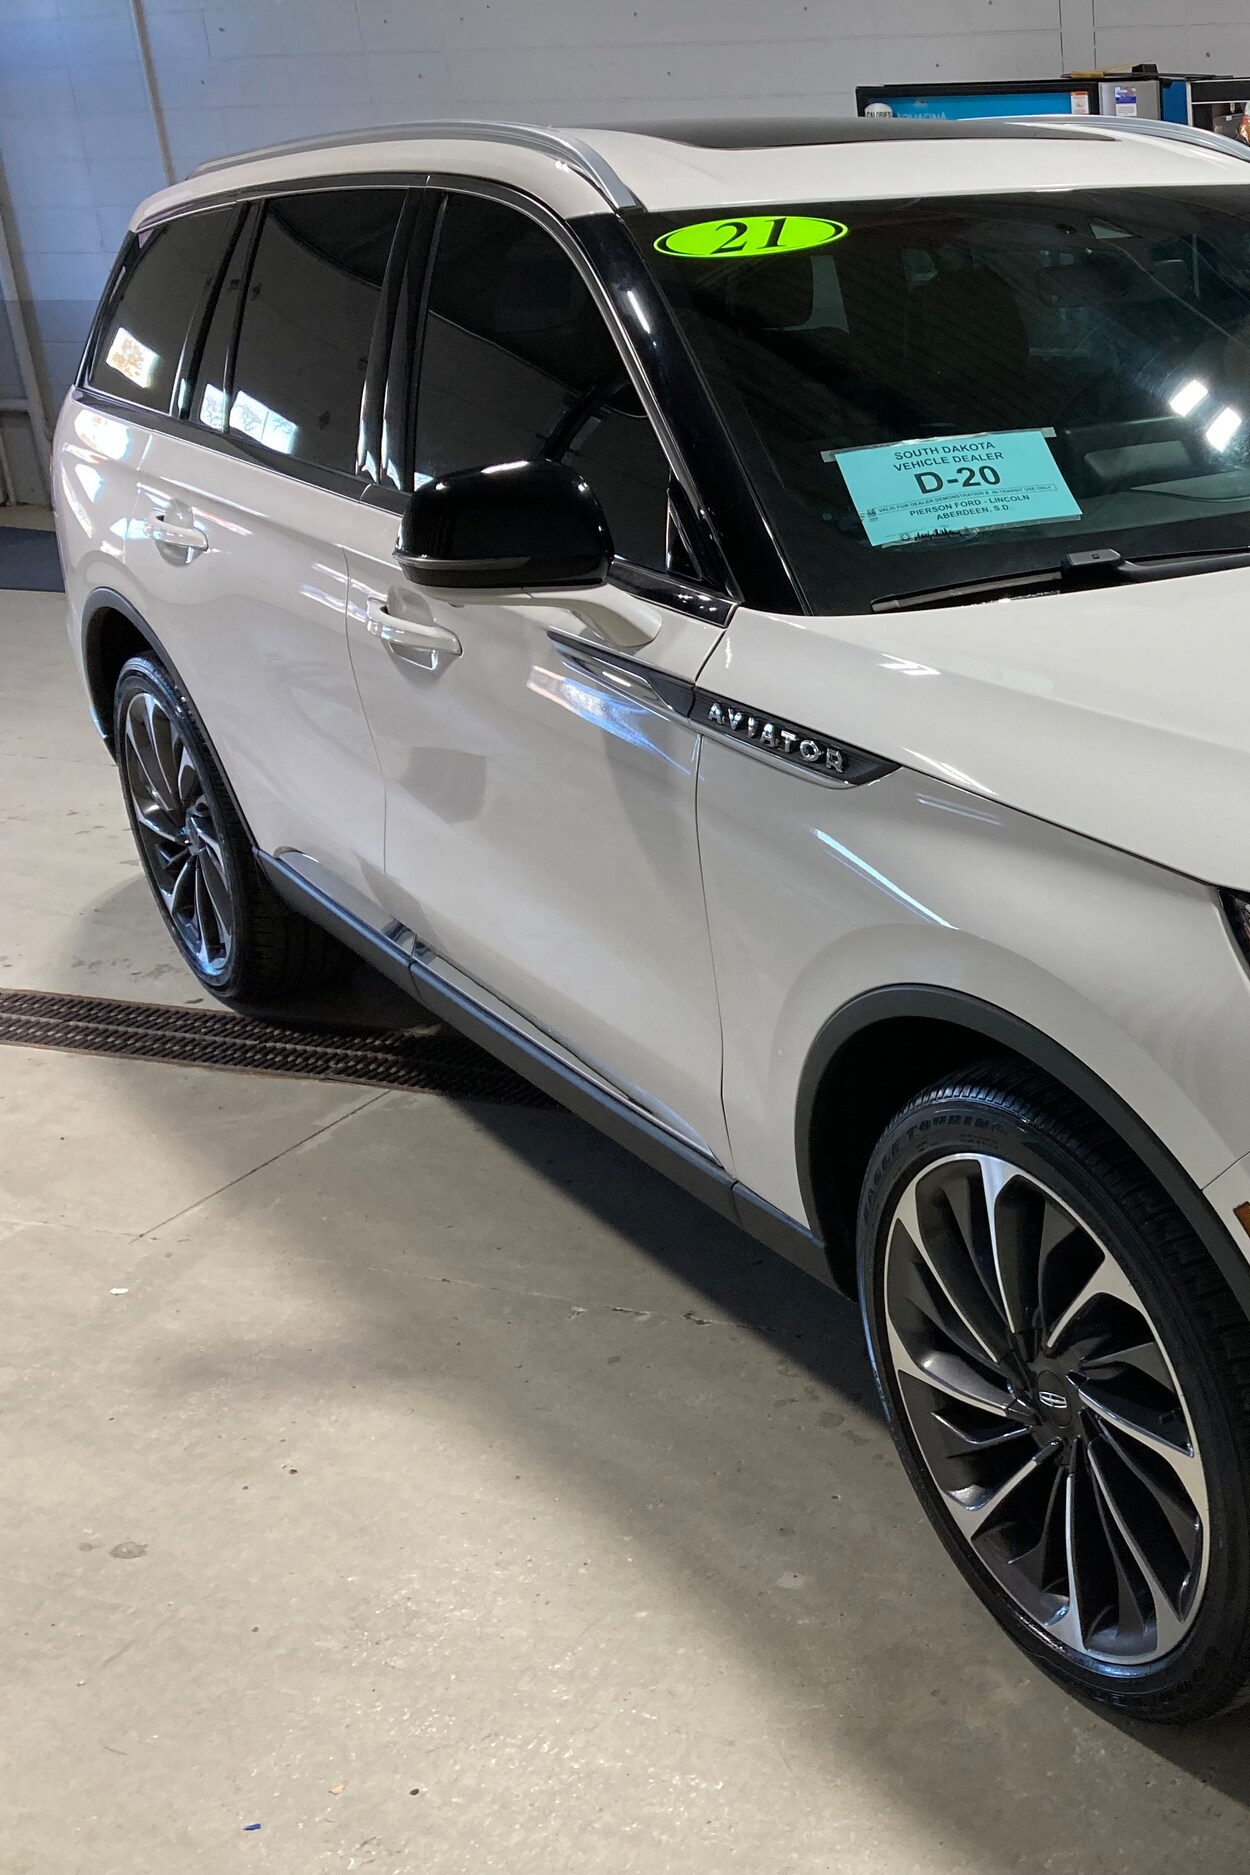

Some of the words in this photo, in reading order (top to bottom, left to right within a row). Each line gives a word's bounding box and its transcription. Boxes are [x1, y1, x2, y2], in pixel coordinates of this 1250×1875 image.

[709, 217, 787, 255] 21
[893, 459, 950, 472] VEHICLE
[952, 451, 1005, 463] DEALER
[894, 446, 940, 460] SOUTH
[941, 441, 996, 455] DAKOTA
[914, 465, 1001, 494] D-20
[909, 503, 953, 517] PIERSON
[954, 499, 982, 509] FORD
[988, 494, 1030, 504] LINCOLN
[910, 499, 934, 507] DEALER
[935, 490, 984, 502] DEMONSTRATION
[936, 506, 993, 520] ABERDEEN,
[708, 701, 847, 774] AVIATOR
